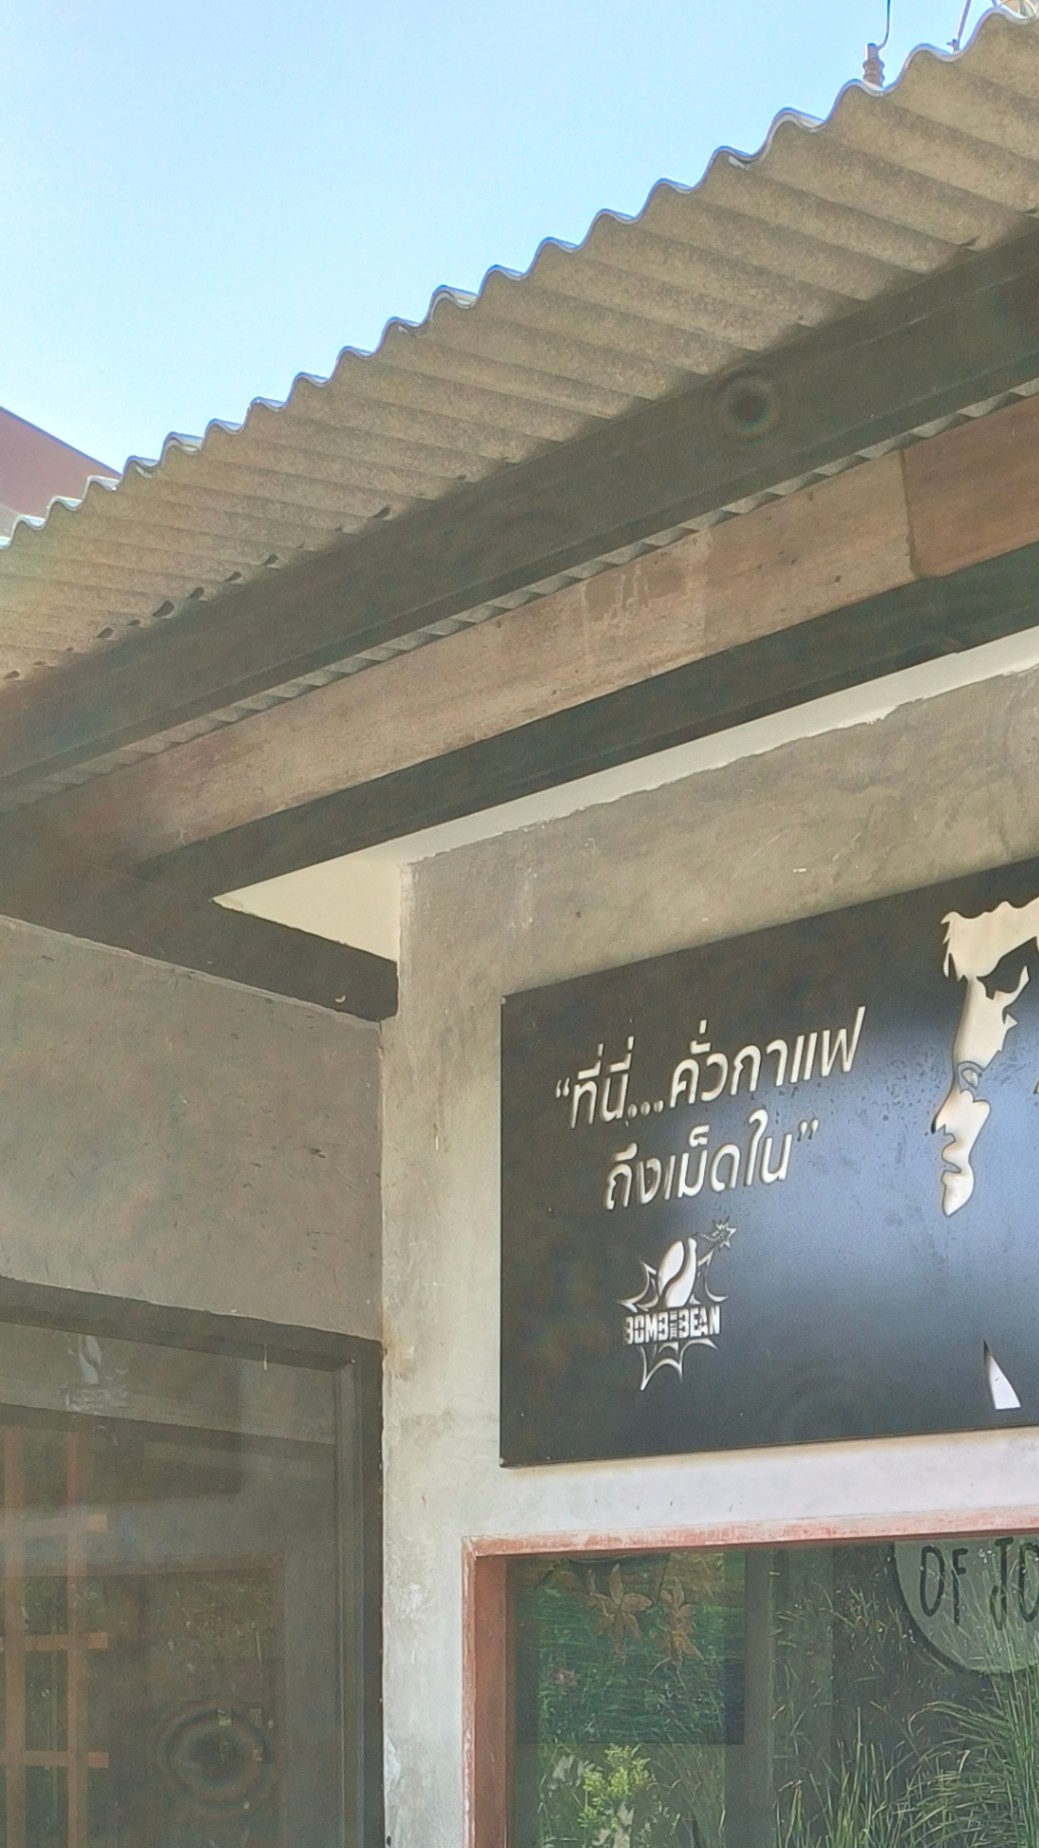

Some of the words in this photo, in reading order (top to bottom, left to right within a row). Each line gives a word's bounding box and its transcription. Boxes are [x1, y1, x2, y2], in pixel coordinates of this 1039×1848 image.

[624, 1311, 669, 1345] BOMB
[678, 1305, 721, 1338] BEAN
[919, 1545, 969, 1626] OF
